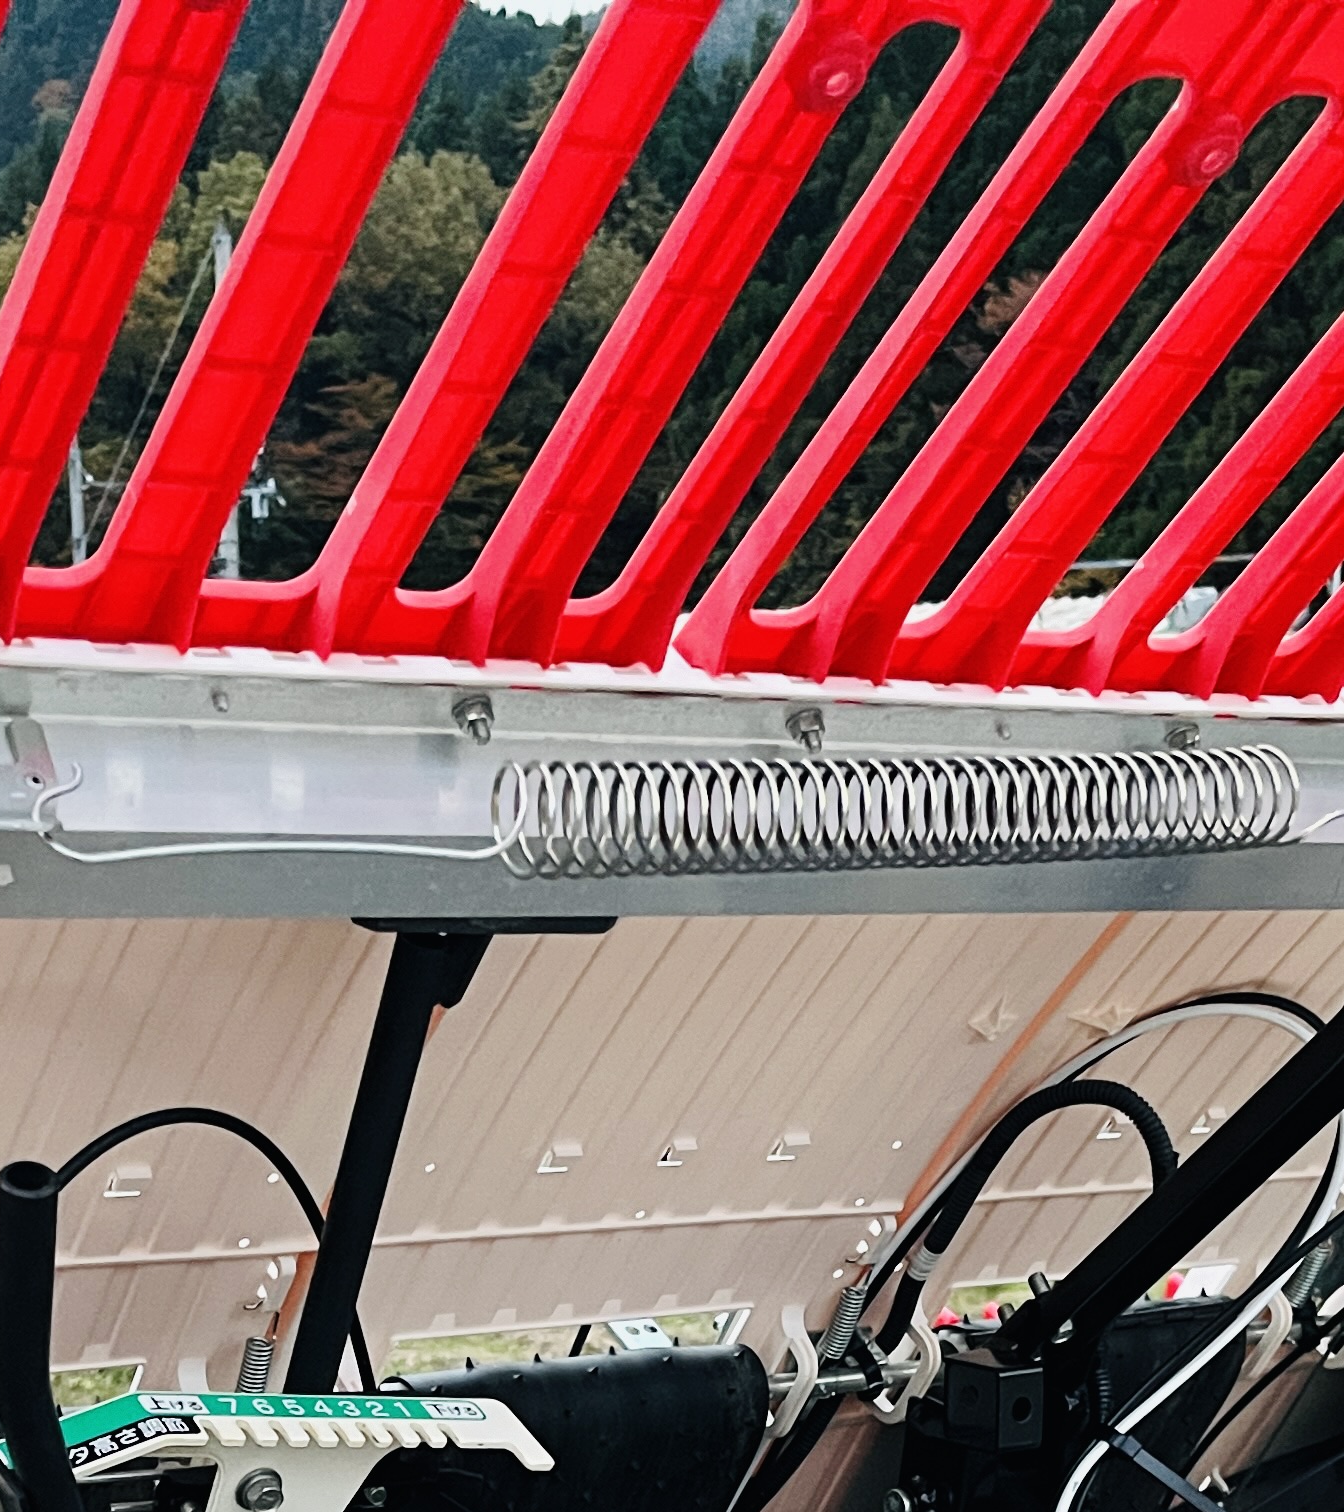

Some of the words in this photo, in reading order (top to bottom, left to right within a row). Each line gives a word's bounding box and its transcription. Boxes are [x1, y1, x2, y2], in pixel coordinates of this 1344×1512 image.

[217, 1398, 237, 1414] 7
[253, 1398, 275, 1415] 6
[282, 1398, 305, 1416] 5
[313, 1399, 334, 1415] 4
[338, 1400, 361, 1417] 3
[365, 1400, 390, 1417] 2
[393, 1401, 412, 1418] 1
